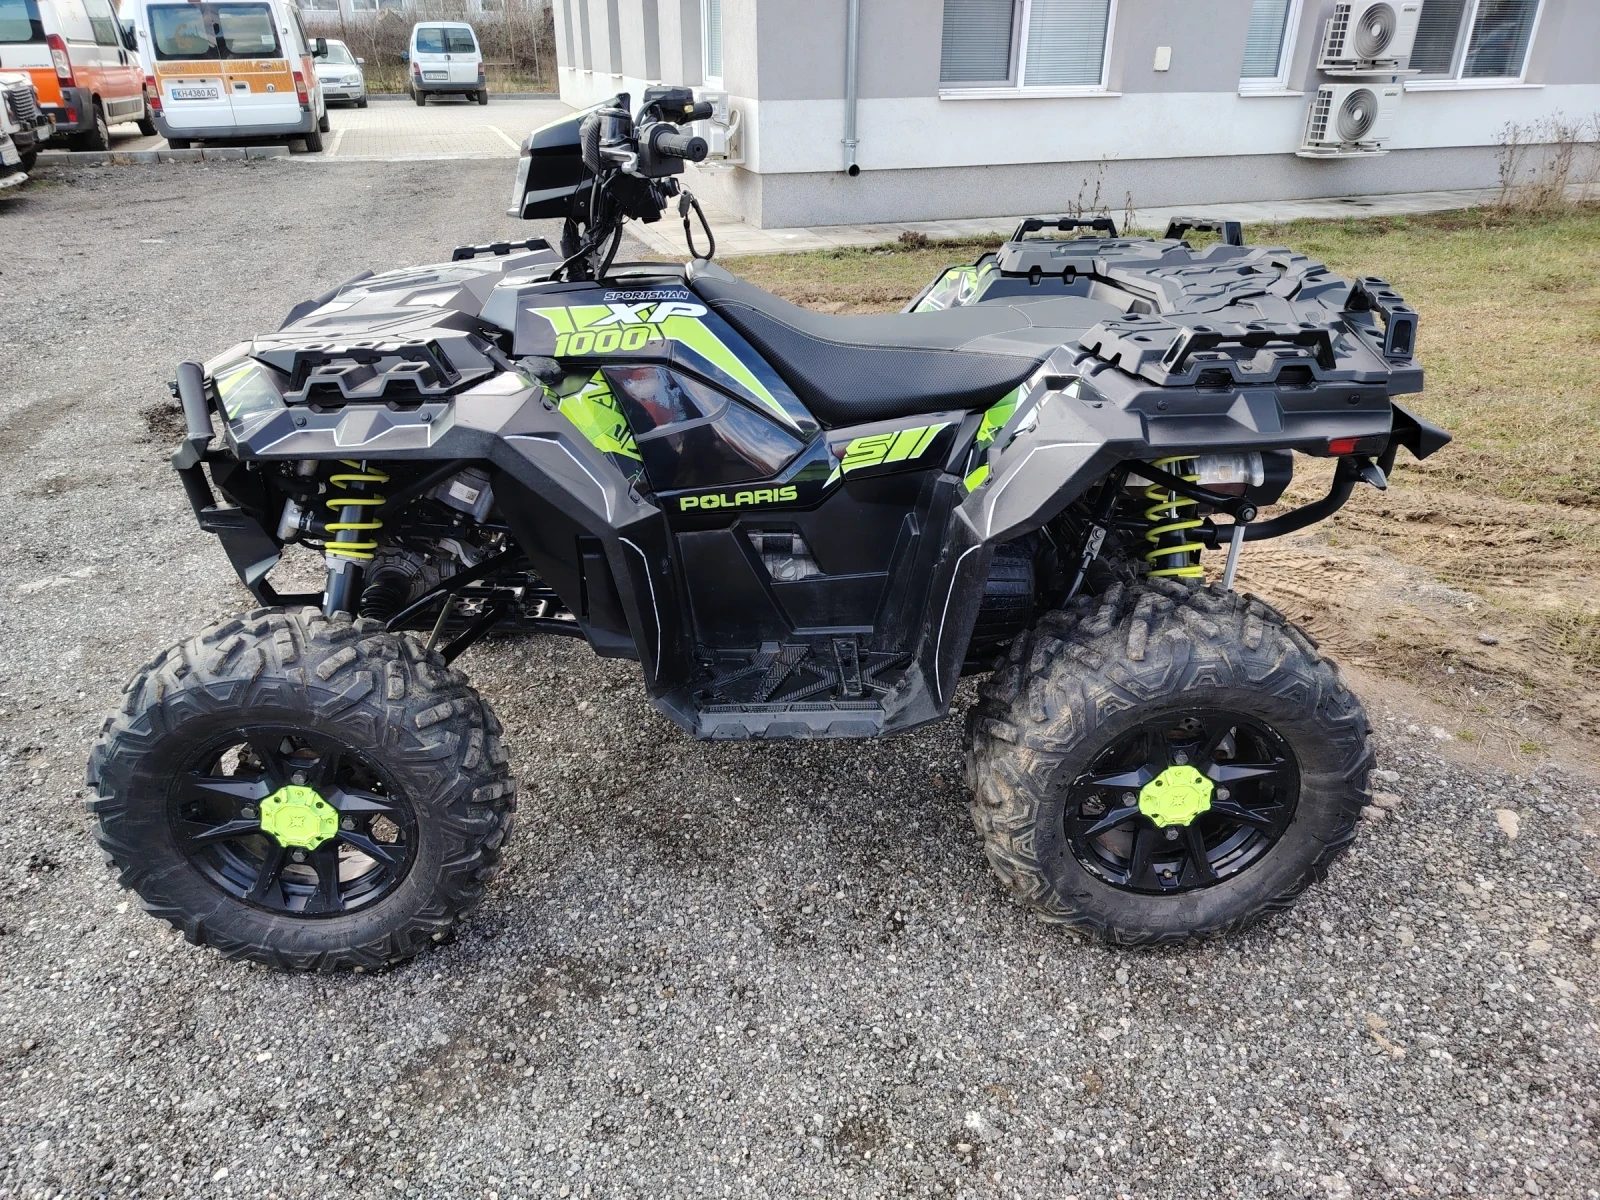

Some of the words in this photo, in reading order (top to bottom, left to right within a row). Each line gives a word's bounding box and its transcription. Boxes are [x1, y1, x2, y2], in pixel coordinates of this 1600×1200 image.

[603, 290, 690, 301] SPORTSMAN
[591, 302, 708, 325] XP
[554, 326, 652, 357] 1000
[679, 485, 798, 511] POLARIS
